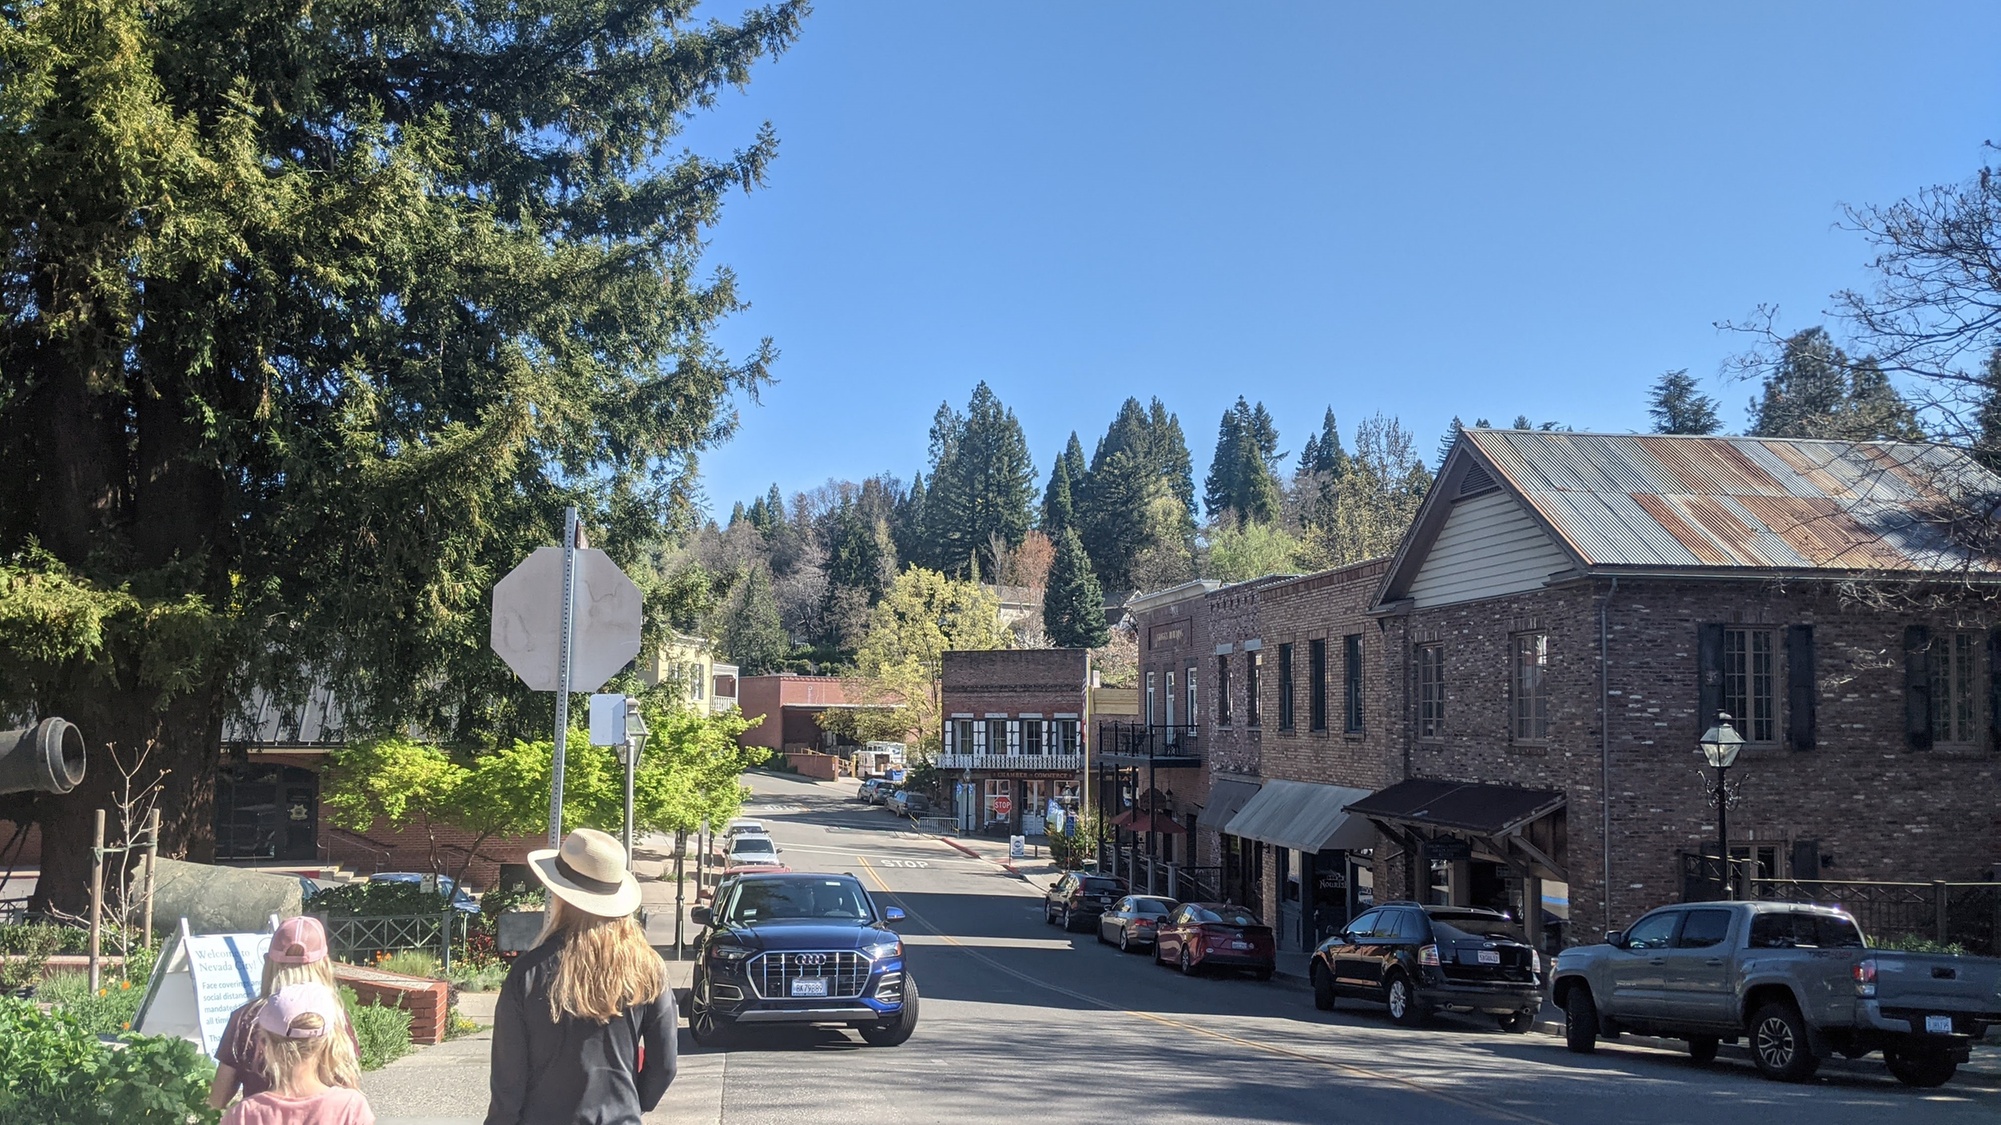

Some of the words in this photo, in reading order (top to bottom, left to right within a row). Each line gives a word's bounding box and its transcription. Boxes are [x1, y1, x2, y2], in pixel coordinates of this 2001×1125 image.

[995, 801, 1011, 809] STOP
[880, 859, 929, 868] STOP
[195, 949, 240, 959] Welcome
[241, 949, 250, 957] to
[199, 961, 232, 971] Nevada
[235, 960, 256, 972] City!
[202, 981, 217, 989] Face
[203, 992, 221, 1001] social
[206, 1017, 214, 1025] all
[209, 1034, 220, 1042] Tha
